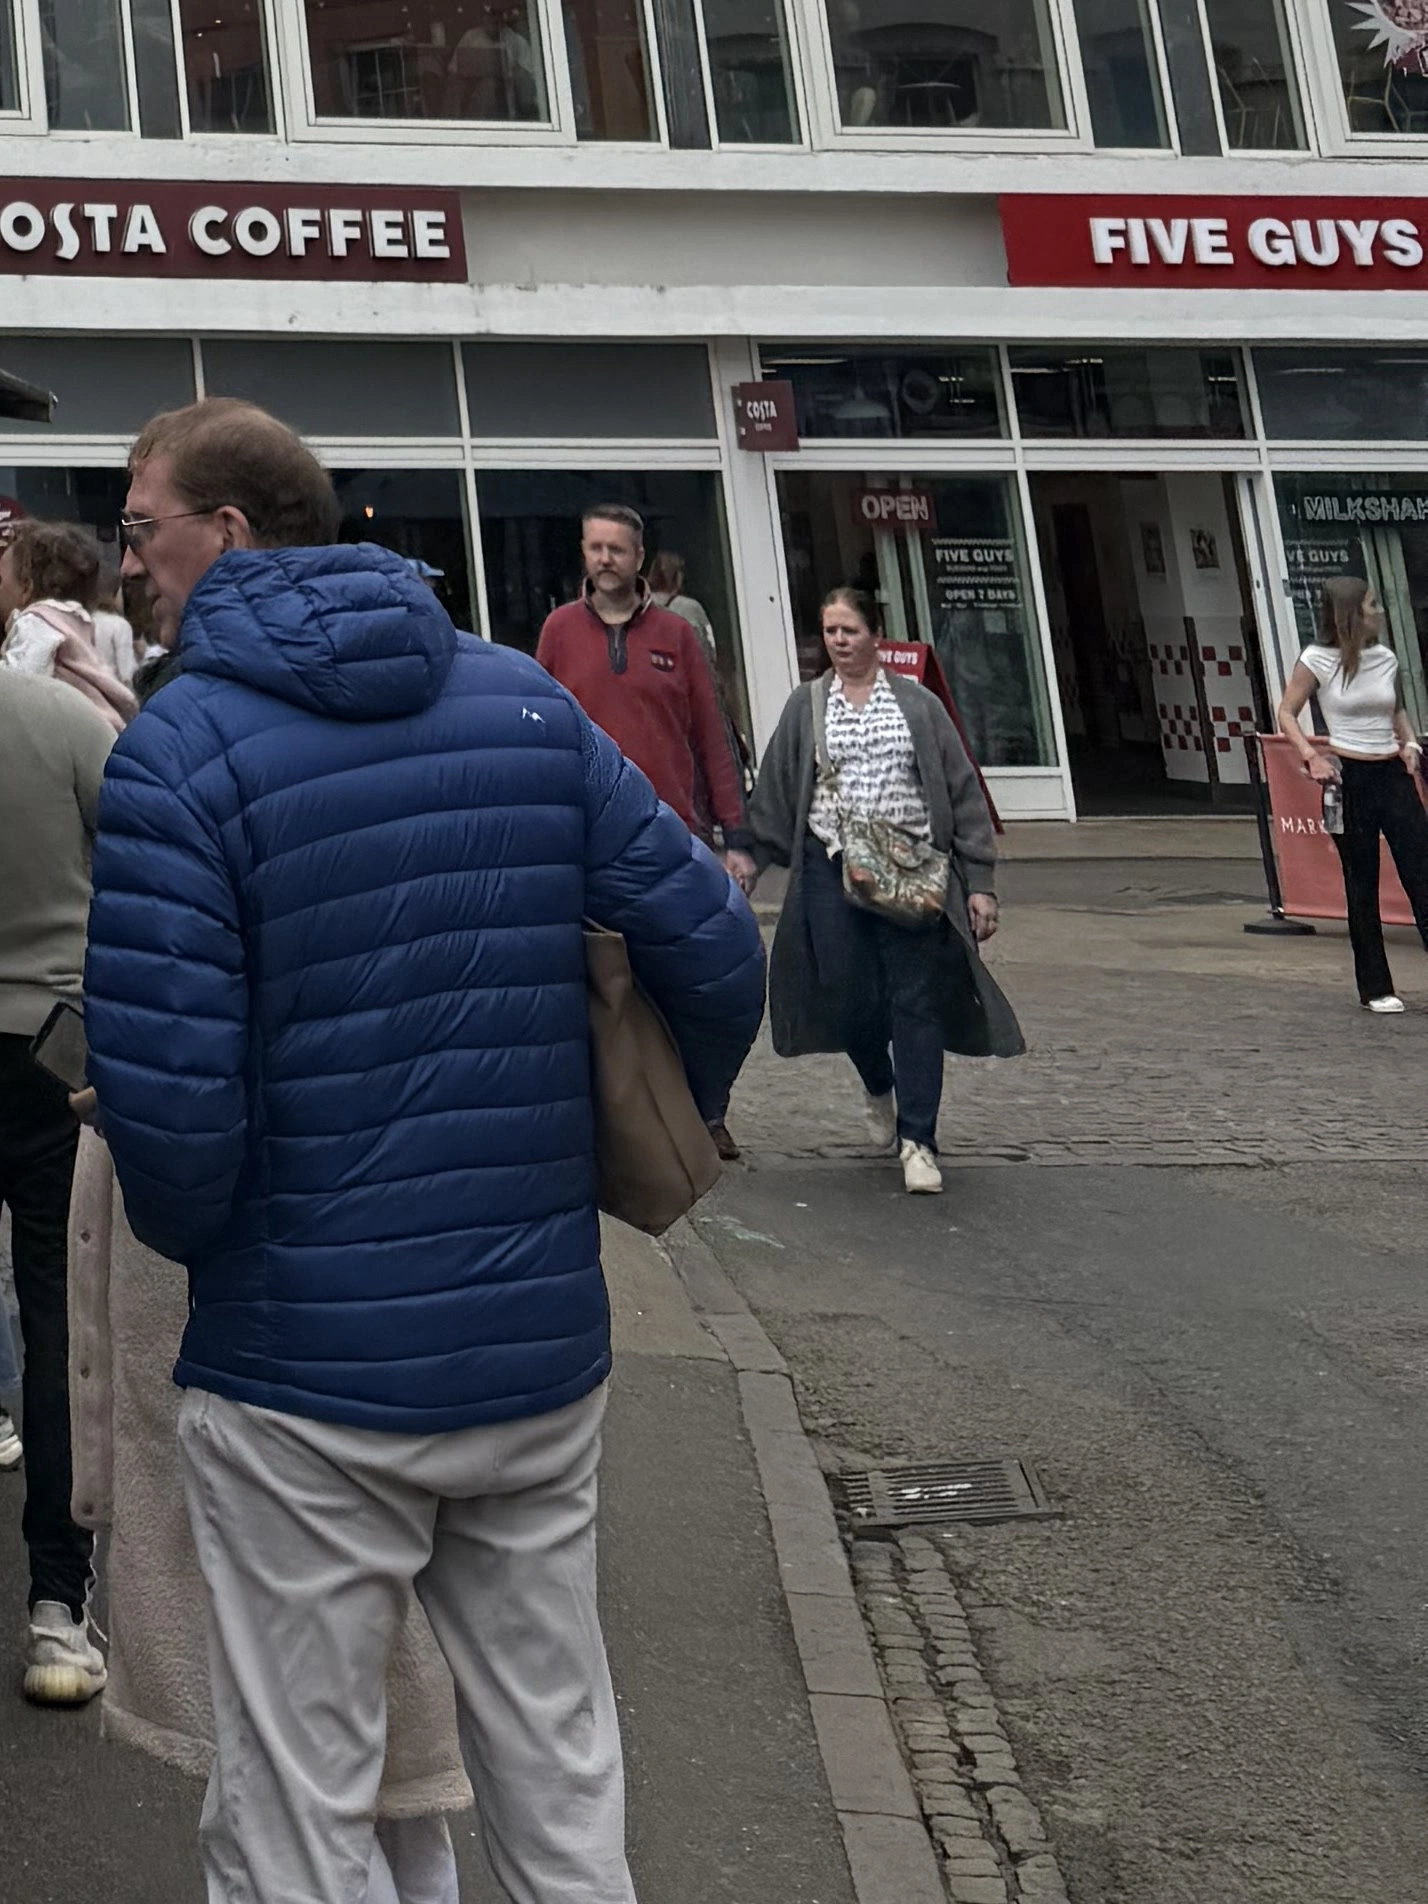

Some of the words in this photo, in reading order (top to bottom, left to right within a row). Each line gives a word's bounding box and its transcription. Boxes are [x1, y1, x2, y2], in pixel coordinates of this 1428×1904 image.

[188, 205, 451, 260] COFFEE
[1090, 217, 1234, 265] FIVE
[1248, 218, 1424, 267] GUYS
[746, 400, 778, 422] COSTA
[861, 495, 929, 521] OPEN
[935, 548, 969, 563] FIVE
[973, 549, 1015, 564] GUYS
[1309, 549, 1350, 563] GUYS
